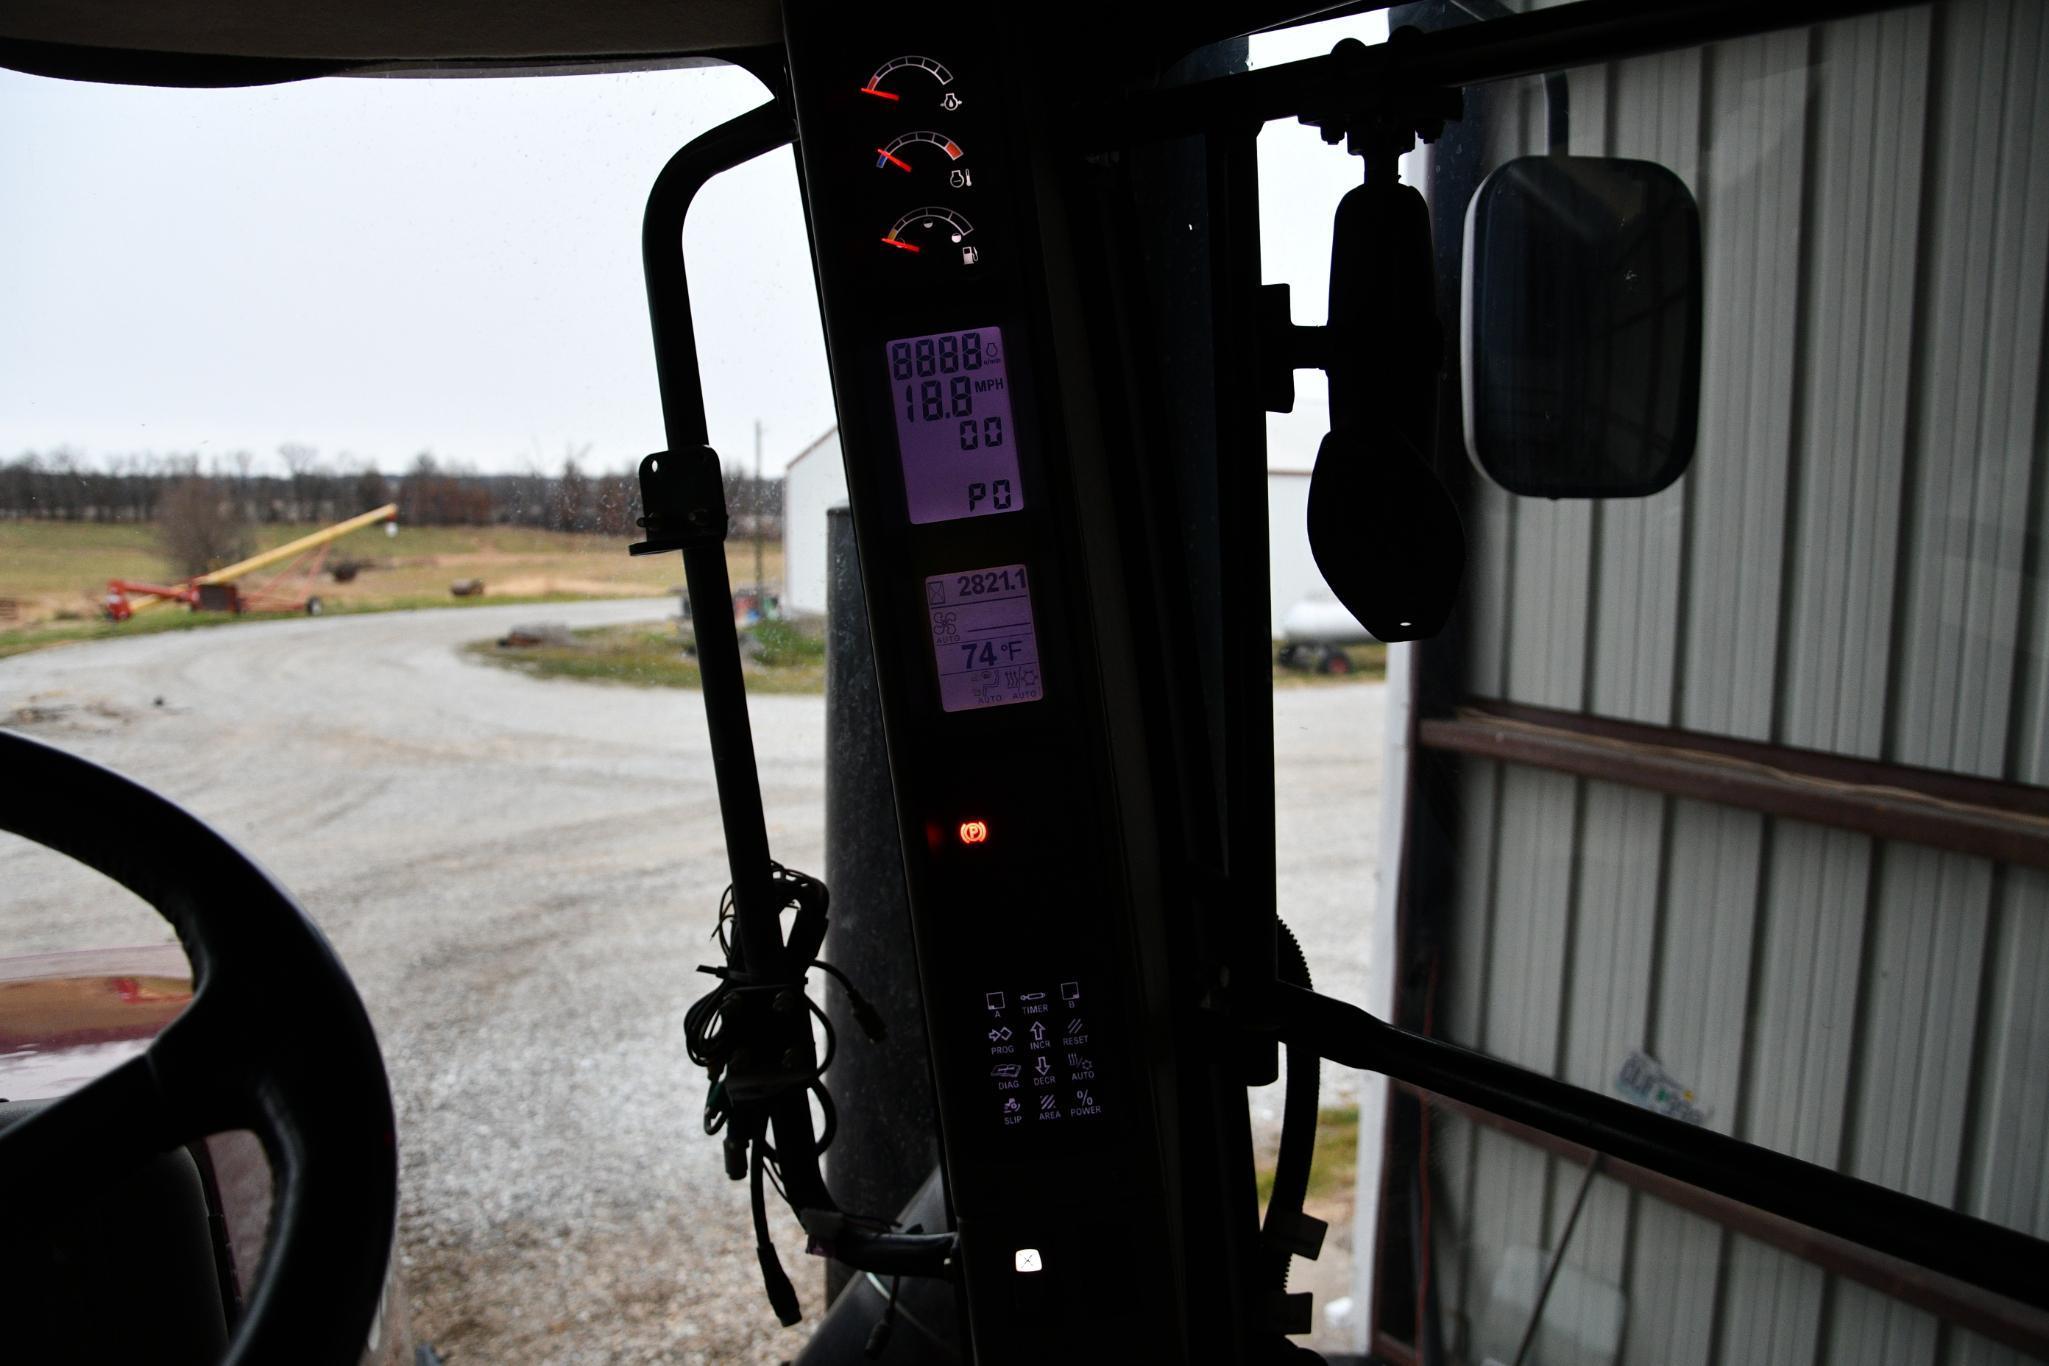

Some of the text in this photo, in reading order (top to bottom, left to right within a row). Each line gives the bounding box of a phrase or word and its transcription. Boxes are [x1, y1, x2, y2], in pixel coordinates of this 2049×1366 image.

[892, 332, 982, 381] 8888
[905, 375, 1004, 423] 18.8 MPH
[957, 568, 1027, 596] 2821.1
[961, 641, 998, 669] 74
[977, 694, 1002, 704] AUTO
[1012, 690, 1037, 700] AUTO
[994, 1010, 1002, 1018] A
[1022, 1003, 1049, 1015] TIMER
[1030, 1039, 1051, 1050] INCR
[1062, 1034, 1089, 1046] RESET
[991, 1044, 1015, 1055] PROG
[1033, 1075, 1056, 1086] DECR
[1071, 1071, 1095, 1081] AUTO
[998, 1080, 1020, 1090] DIAG
[1039, 1110, 1062, 1121] AREA
[1070, 1105, 1102, 1117] POWER
[1004, 1115, 1023, 1126] SLIP
